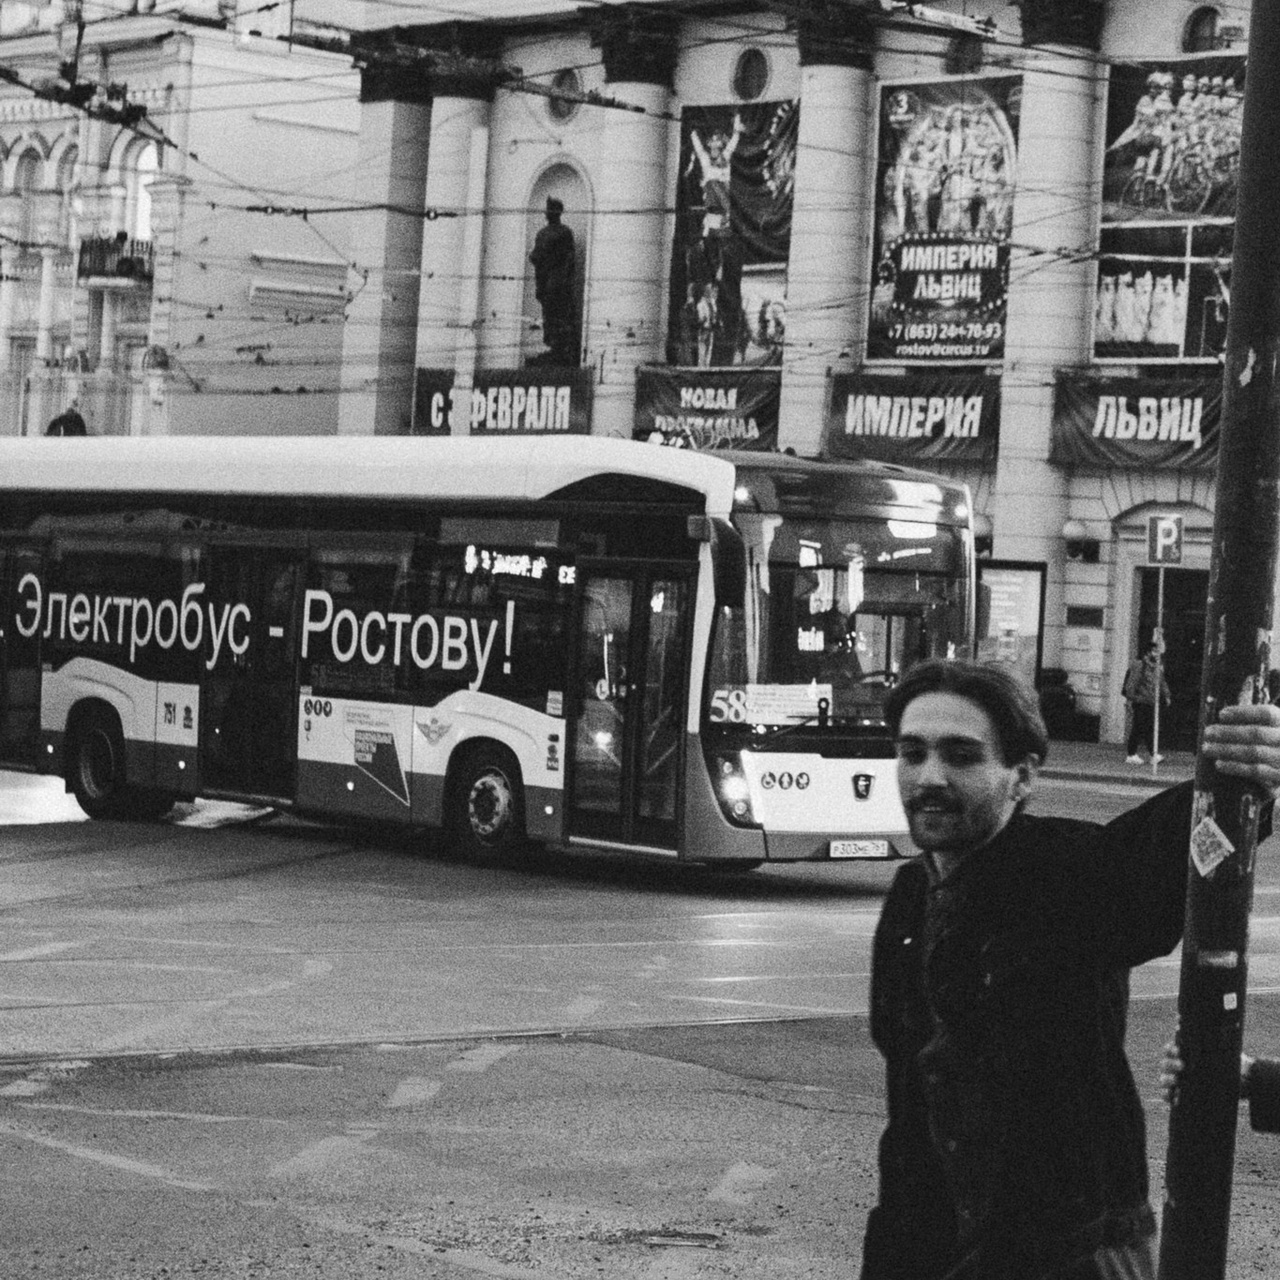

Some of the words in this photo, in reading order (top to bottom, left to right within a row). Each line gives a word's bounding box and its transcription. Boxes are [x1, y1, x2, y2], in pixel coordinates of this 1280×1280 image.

[901, 244, 998, 271] ИМПЕРИЯ
[914, 274, 982, 303] ЛЬВИЦ
[471, 386, 571, 429] ФЕВРАЛЯ
[680, 387, 738, 410] НОВАЯ
[845, 394, 983, 438] ИМПЕРИЯ
[1092, 395, 1203, 449] ЛЬВИЦ
[15, 573, 251, 670] Электробус
[301, 588, 515, 691] Ростову!
[710, 690, 746, 723] 58
